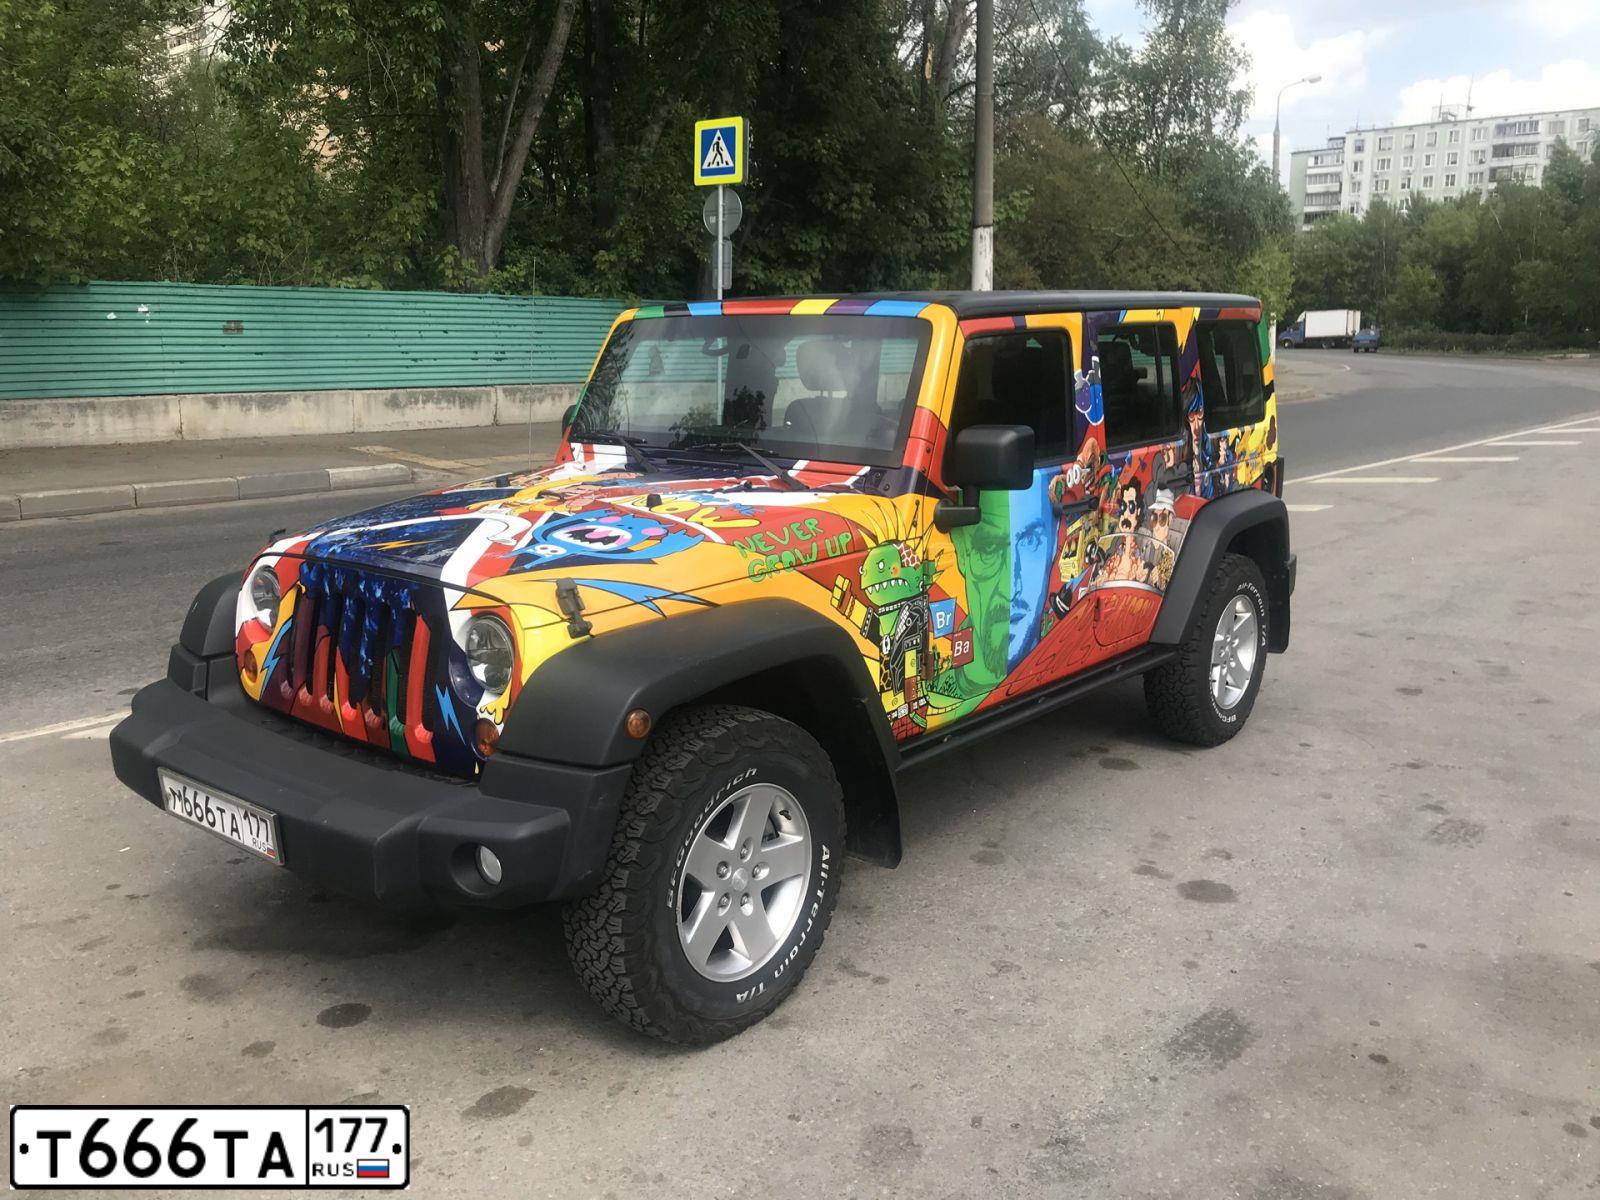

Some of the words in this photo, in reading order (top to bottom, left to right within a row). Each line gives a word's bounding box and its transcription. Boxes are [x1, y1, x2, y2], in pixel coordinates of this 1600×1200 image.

[733, 518, 824, 558] NEVER
[748, 541, 818, 583] GROW
[824, 531, 852, 558] UP
[935, 611, 952, 629] Br
[954, 640, 970, 657] Ba
[252, 837, 267, 852] RUS
[774, 844, 830, 978] All-Terrain
[736, 981, 767, 1004] T/A
